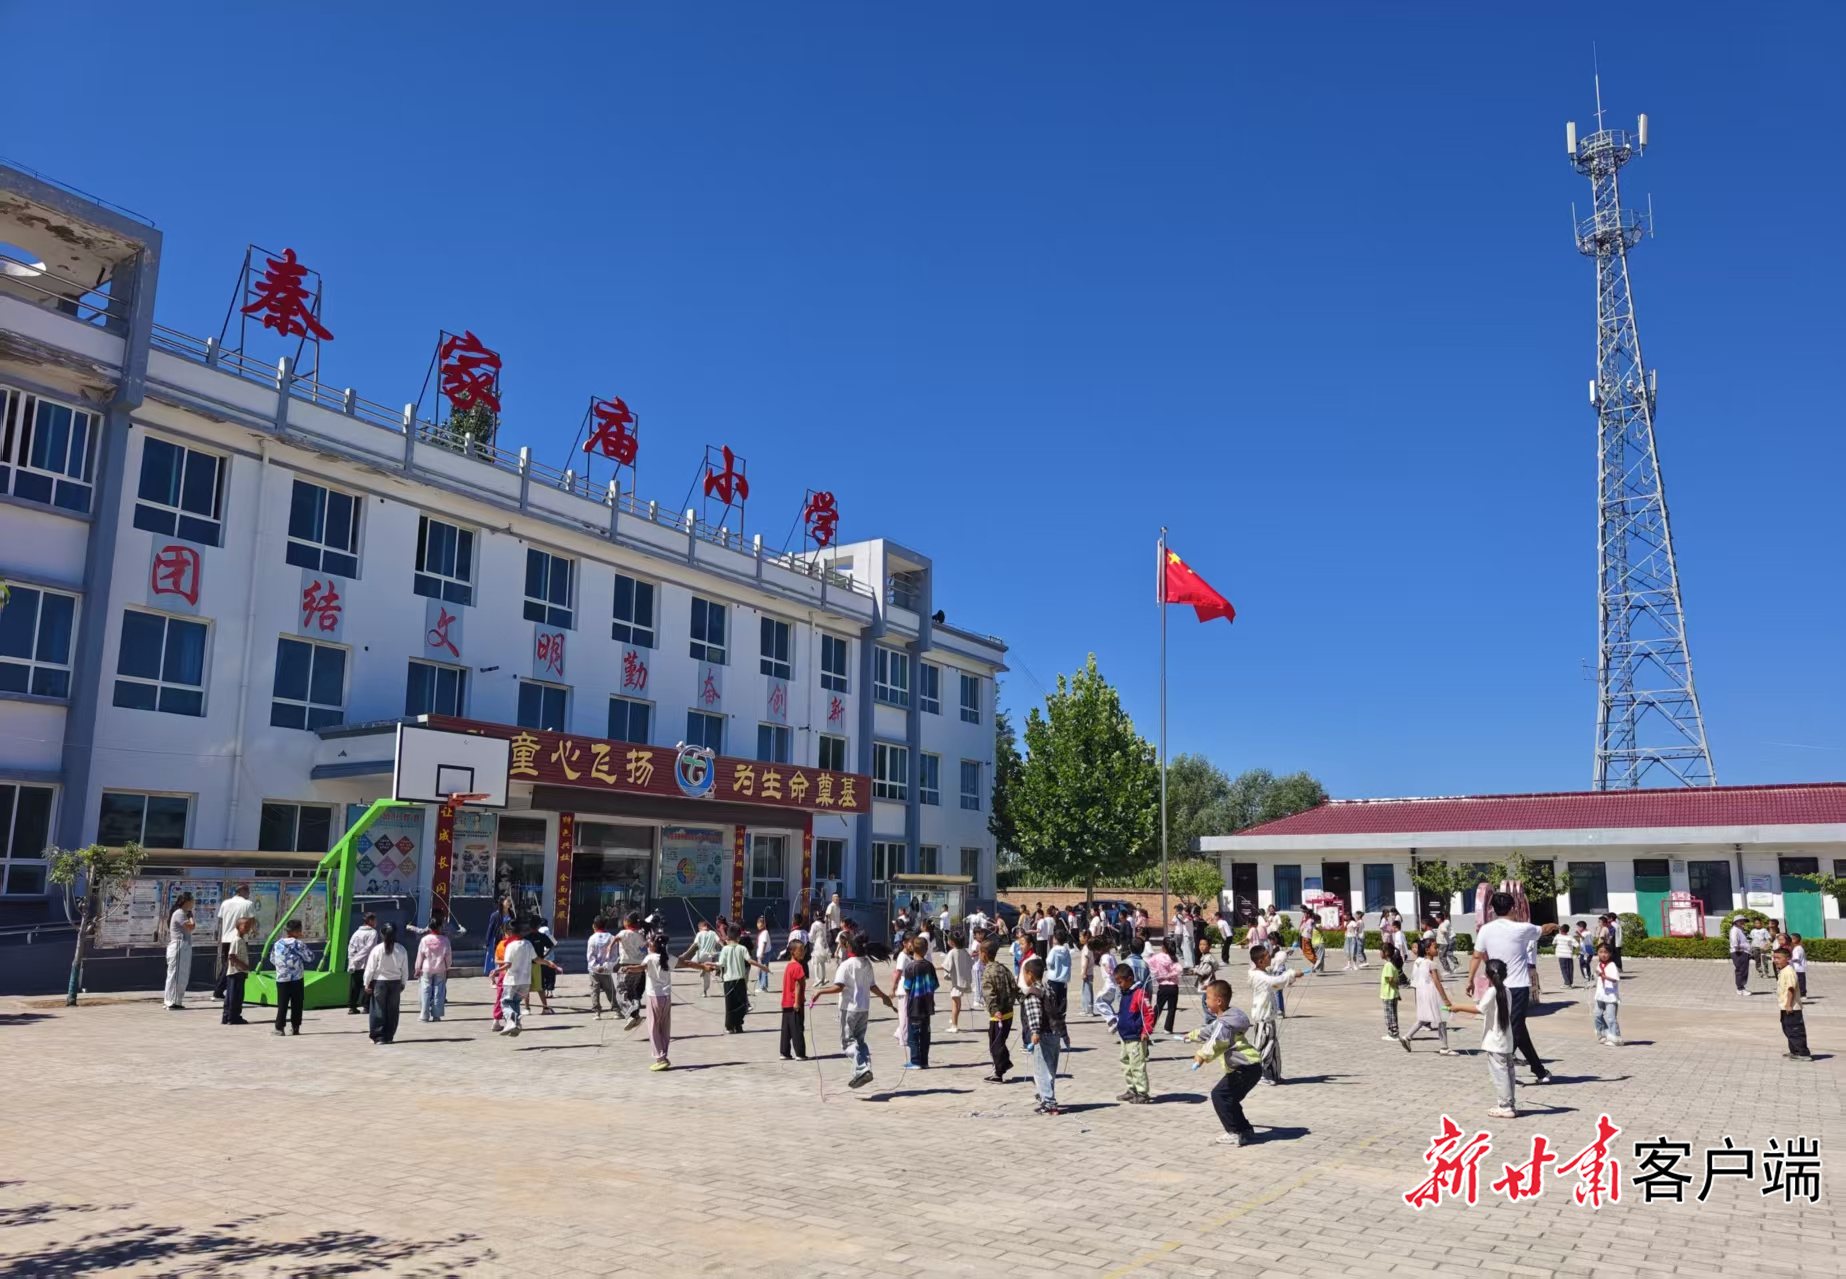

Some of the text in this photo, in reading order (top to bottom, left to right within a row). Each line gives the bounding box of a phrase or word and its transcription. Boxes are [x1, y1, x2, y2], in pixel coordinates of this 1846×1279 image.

[242, 248, 838, 546] 秦家庙小学
[466, 729, 857, 807] 童心飞扬 为生命奠基
